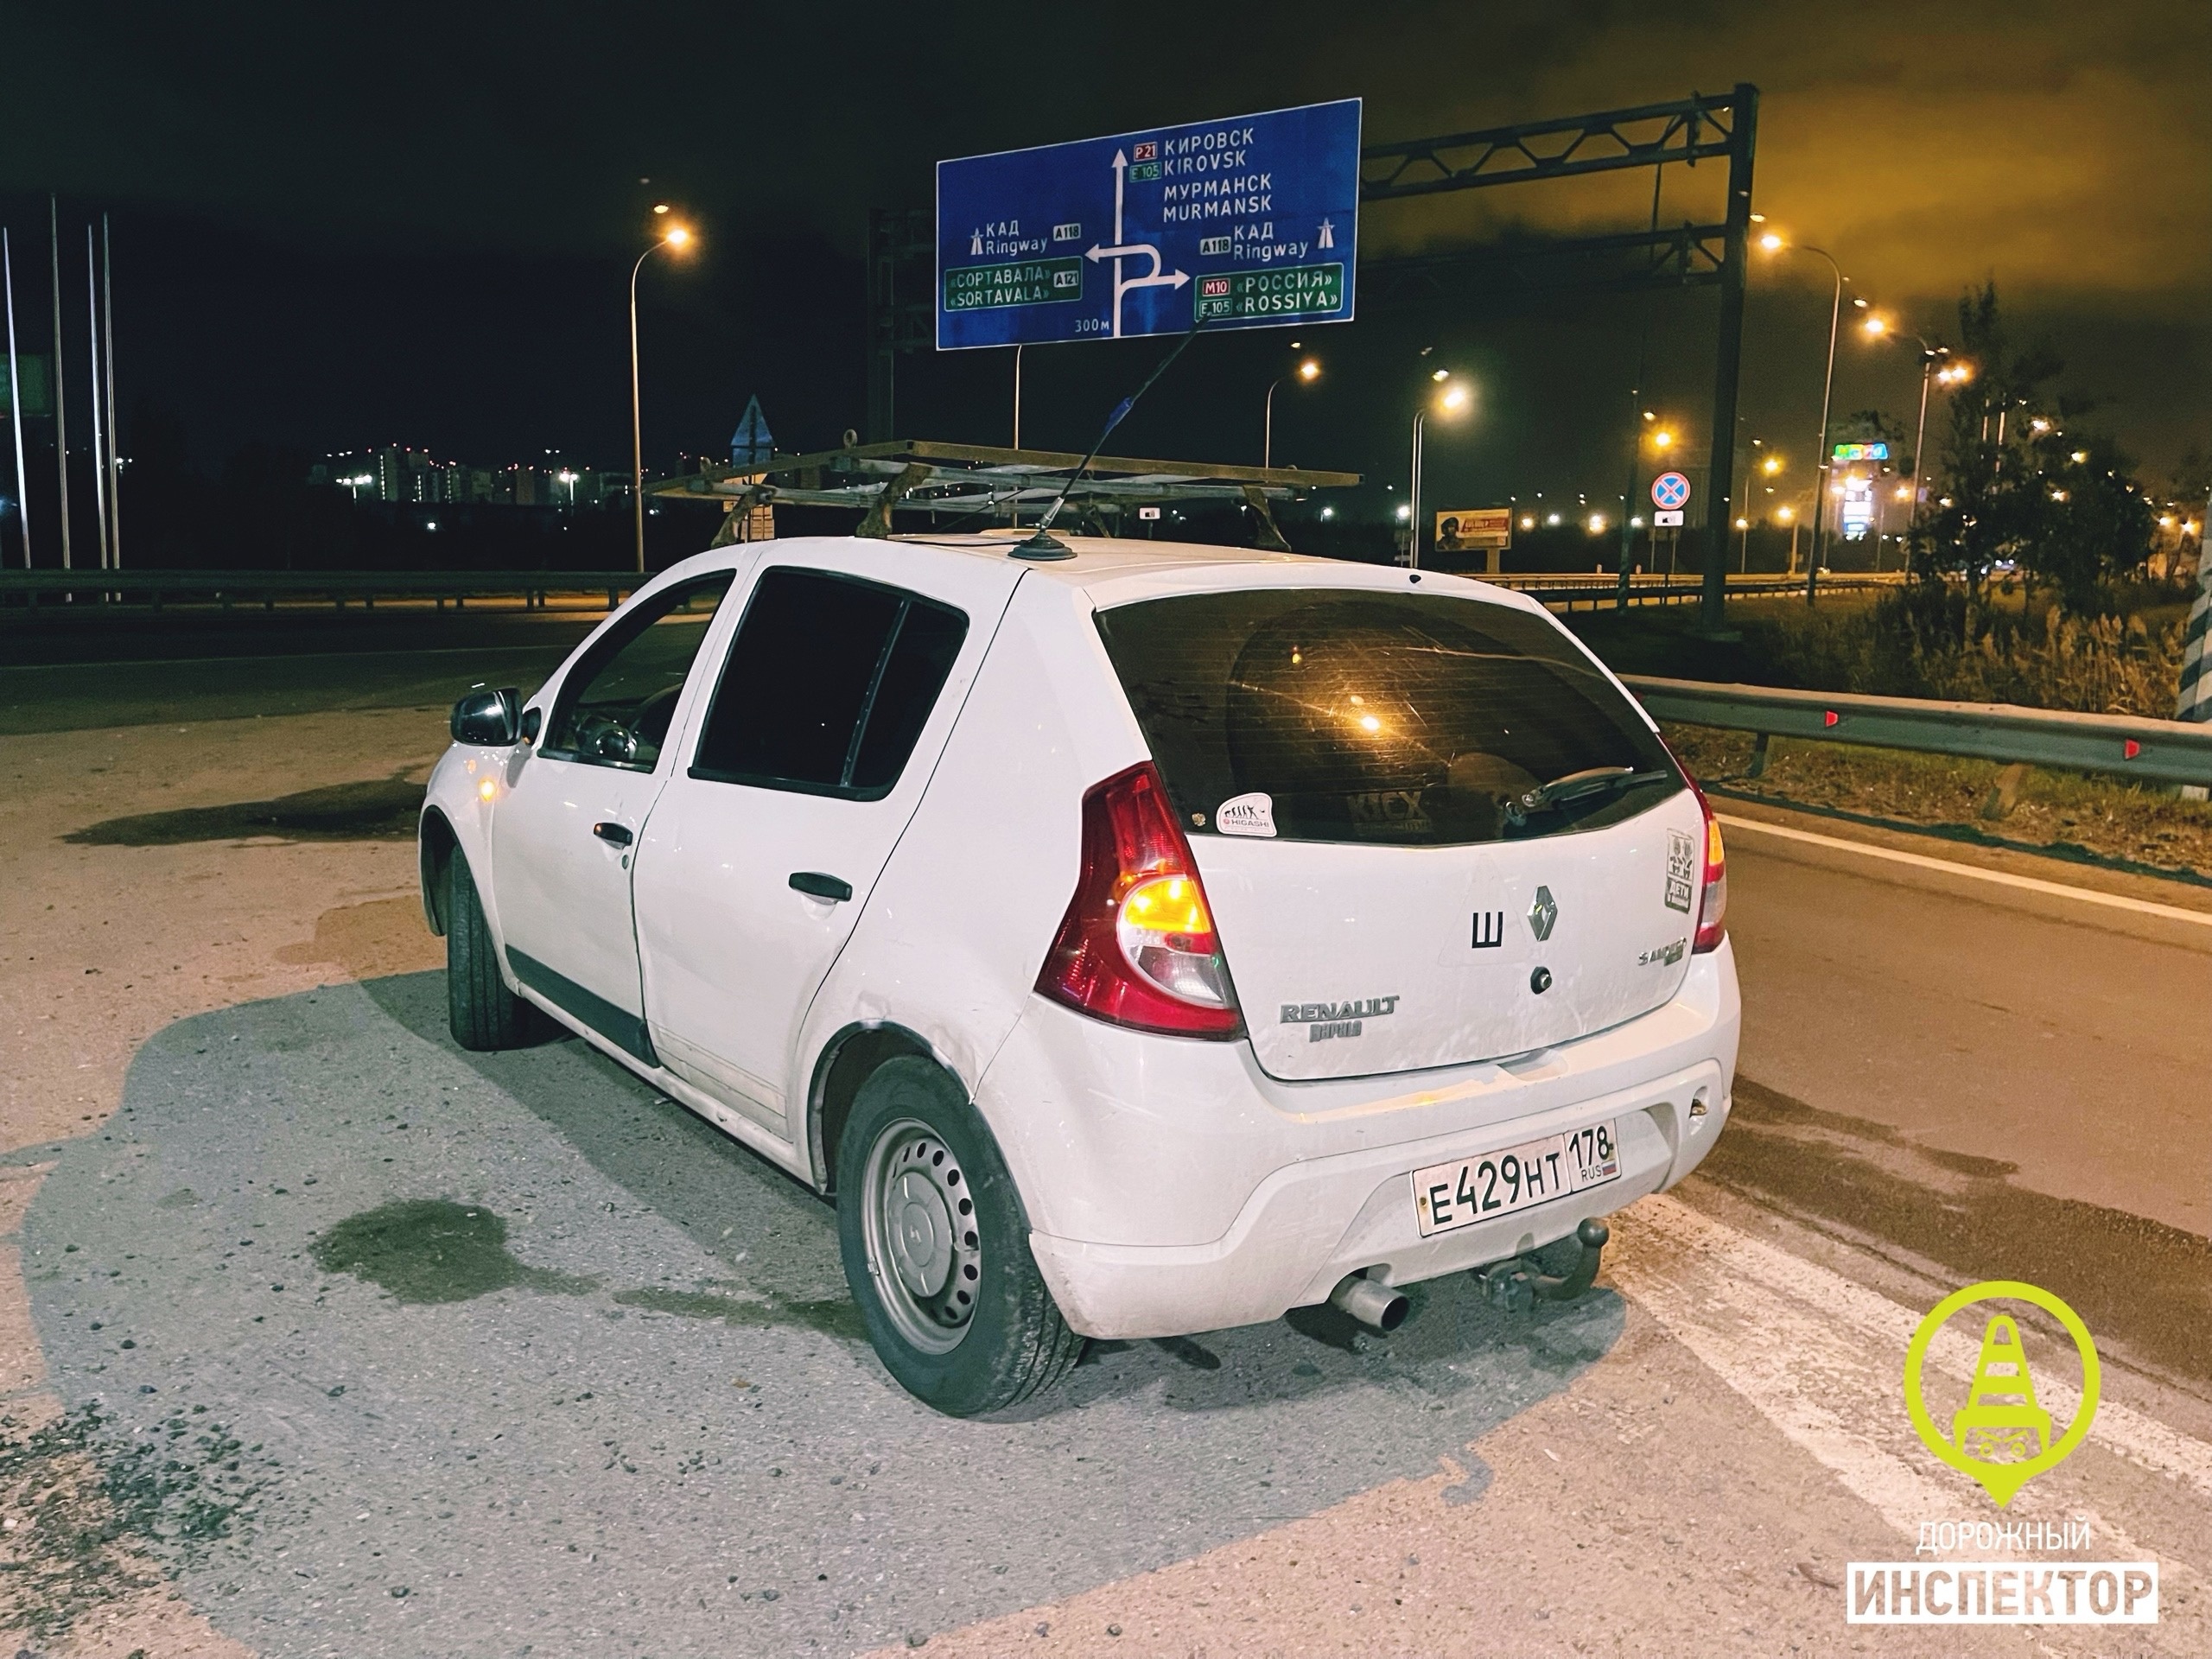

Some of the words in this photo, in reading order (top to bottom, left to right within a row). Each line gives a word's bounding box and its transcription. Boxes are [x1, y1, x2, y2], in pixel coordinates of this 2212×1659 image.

[1165, 128, 1254, 156] КИРОВСК
[1164, 149, 1246, 176] KIROVSK
[1164, 173, 1272, 201] МУРМАНСК
[1163, 194, 1272, 223] MURMANSK
[986, 219, 1020, 238] КАД
[1234, 221, 1274, 241] КАД
[986, 238, 1048, 257] Ringway
[1233, 242, 1308, 262] Ringway
[950, 266, 1052, 289] «СОРТАВАЛА»
[1236, 270, 1332, 294] «РОССИЯ»
[950, 285, 1050, 307] «SORTAVALA»
[1236, 290, 1338, 313] «ROSSIYA»
[1231, 819, 1270, 828] HIGASHI
[1471, 911, 1503, 949] Ш
[1280, 995, 1401, 1024] RENAULT
[1568, 1125, 1610, 1169] 178
[1581, 1166, 1602, 1183] RUS
